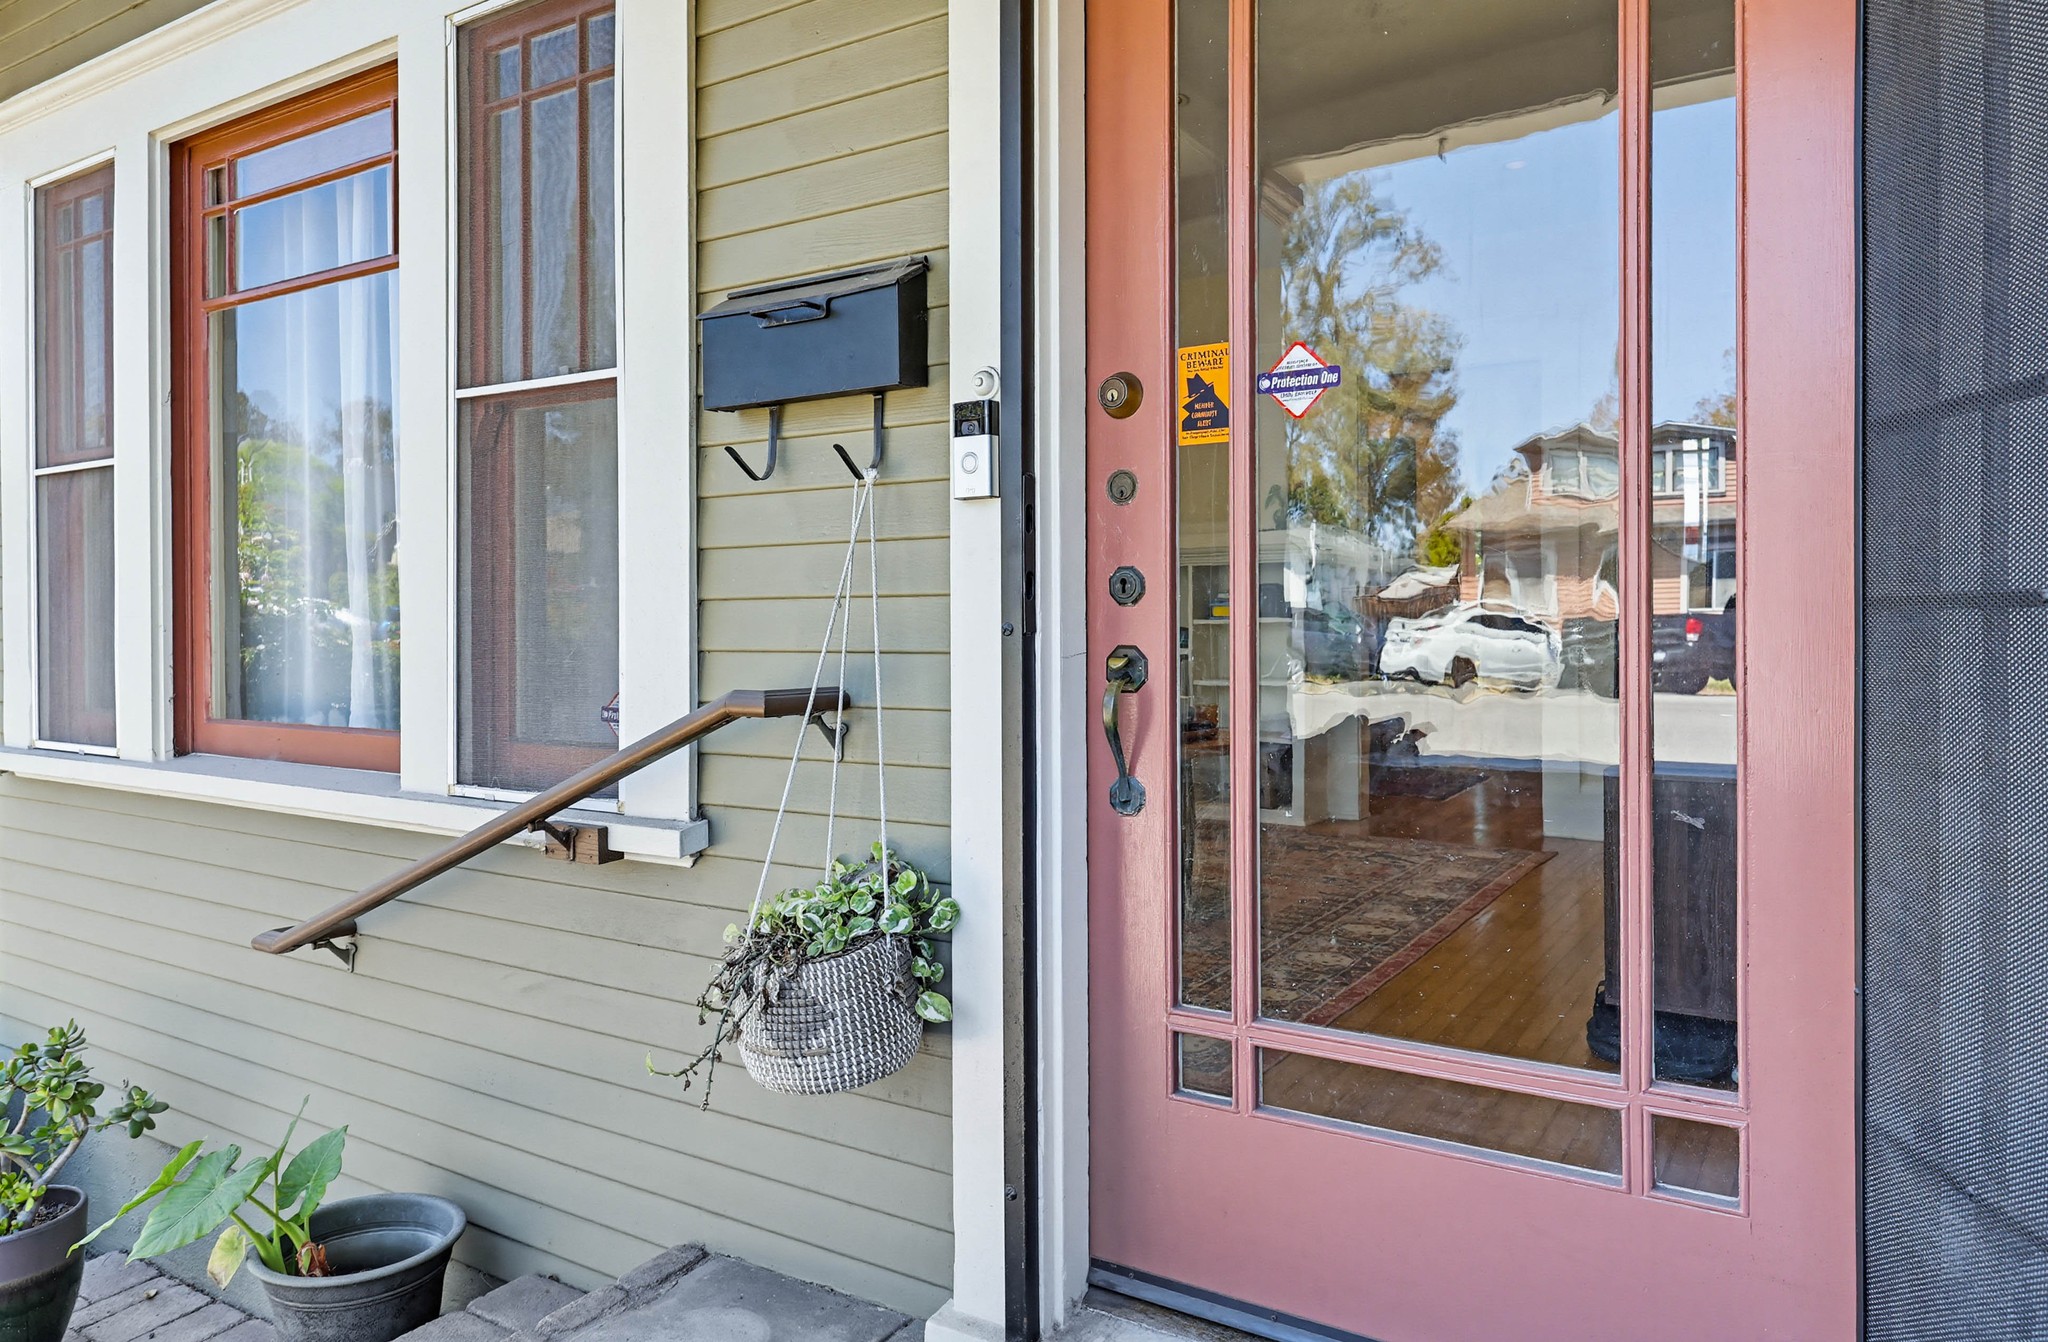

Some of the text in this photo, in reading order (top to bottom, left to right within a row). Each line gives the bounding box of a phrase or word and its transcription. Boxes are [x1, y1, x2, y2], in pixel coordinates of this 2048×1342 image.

[1180, 347, 1229, 361] CRIMINAL
[1186, 357, 1223, 369] BEWARE
[1271, 371, 1339, 389] Protection One
